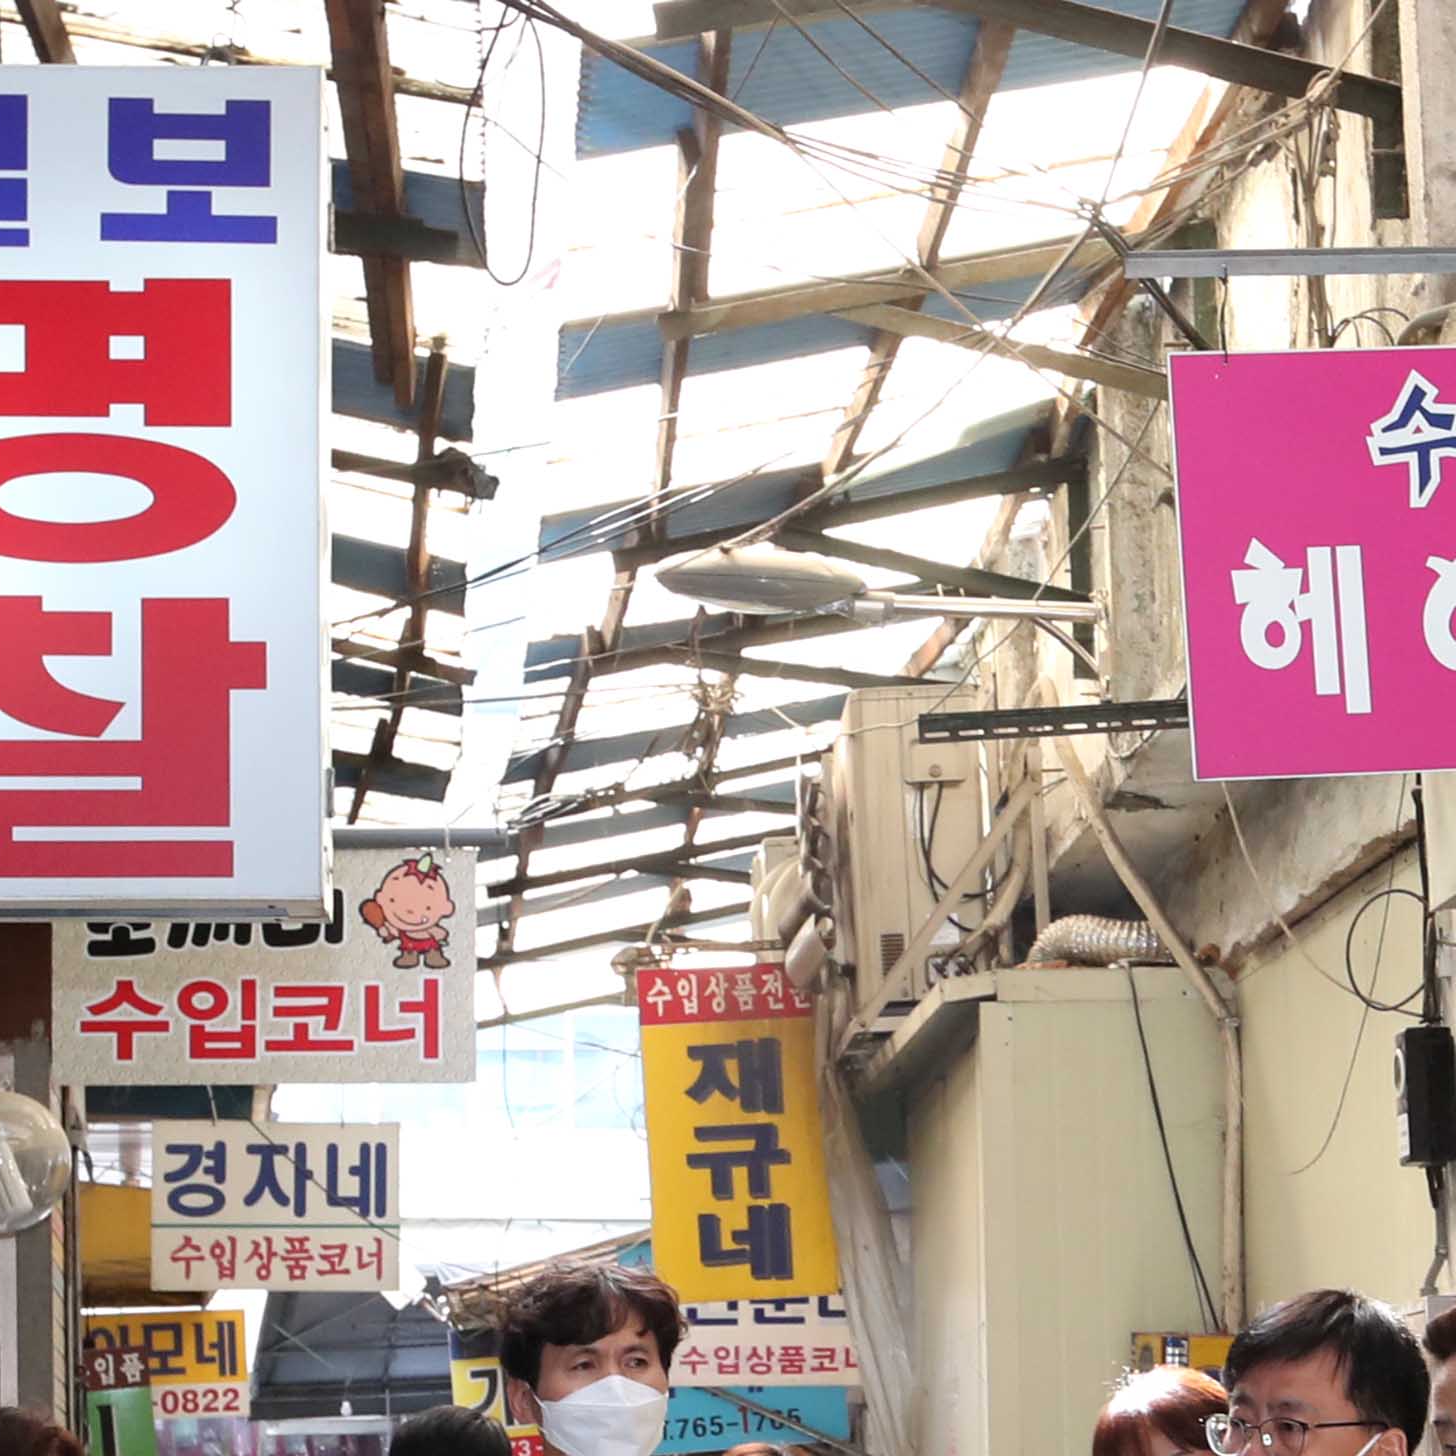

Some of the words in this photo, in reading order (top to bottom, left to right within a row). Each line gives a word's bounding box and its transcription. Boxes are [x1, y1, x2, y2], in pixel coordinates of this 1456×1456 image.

[80, 978, 440, 1061] 수입코너
[163, 1140, 388, 1219] 경자네
[684, 1036, 795, 1281] 재규네
[170, 1235, 385, 1281] 수입상품코너
[85, 1352, 144, 1386] 입품
